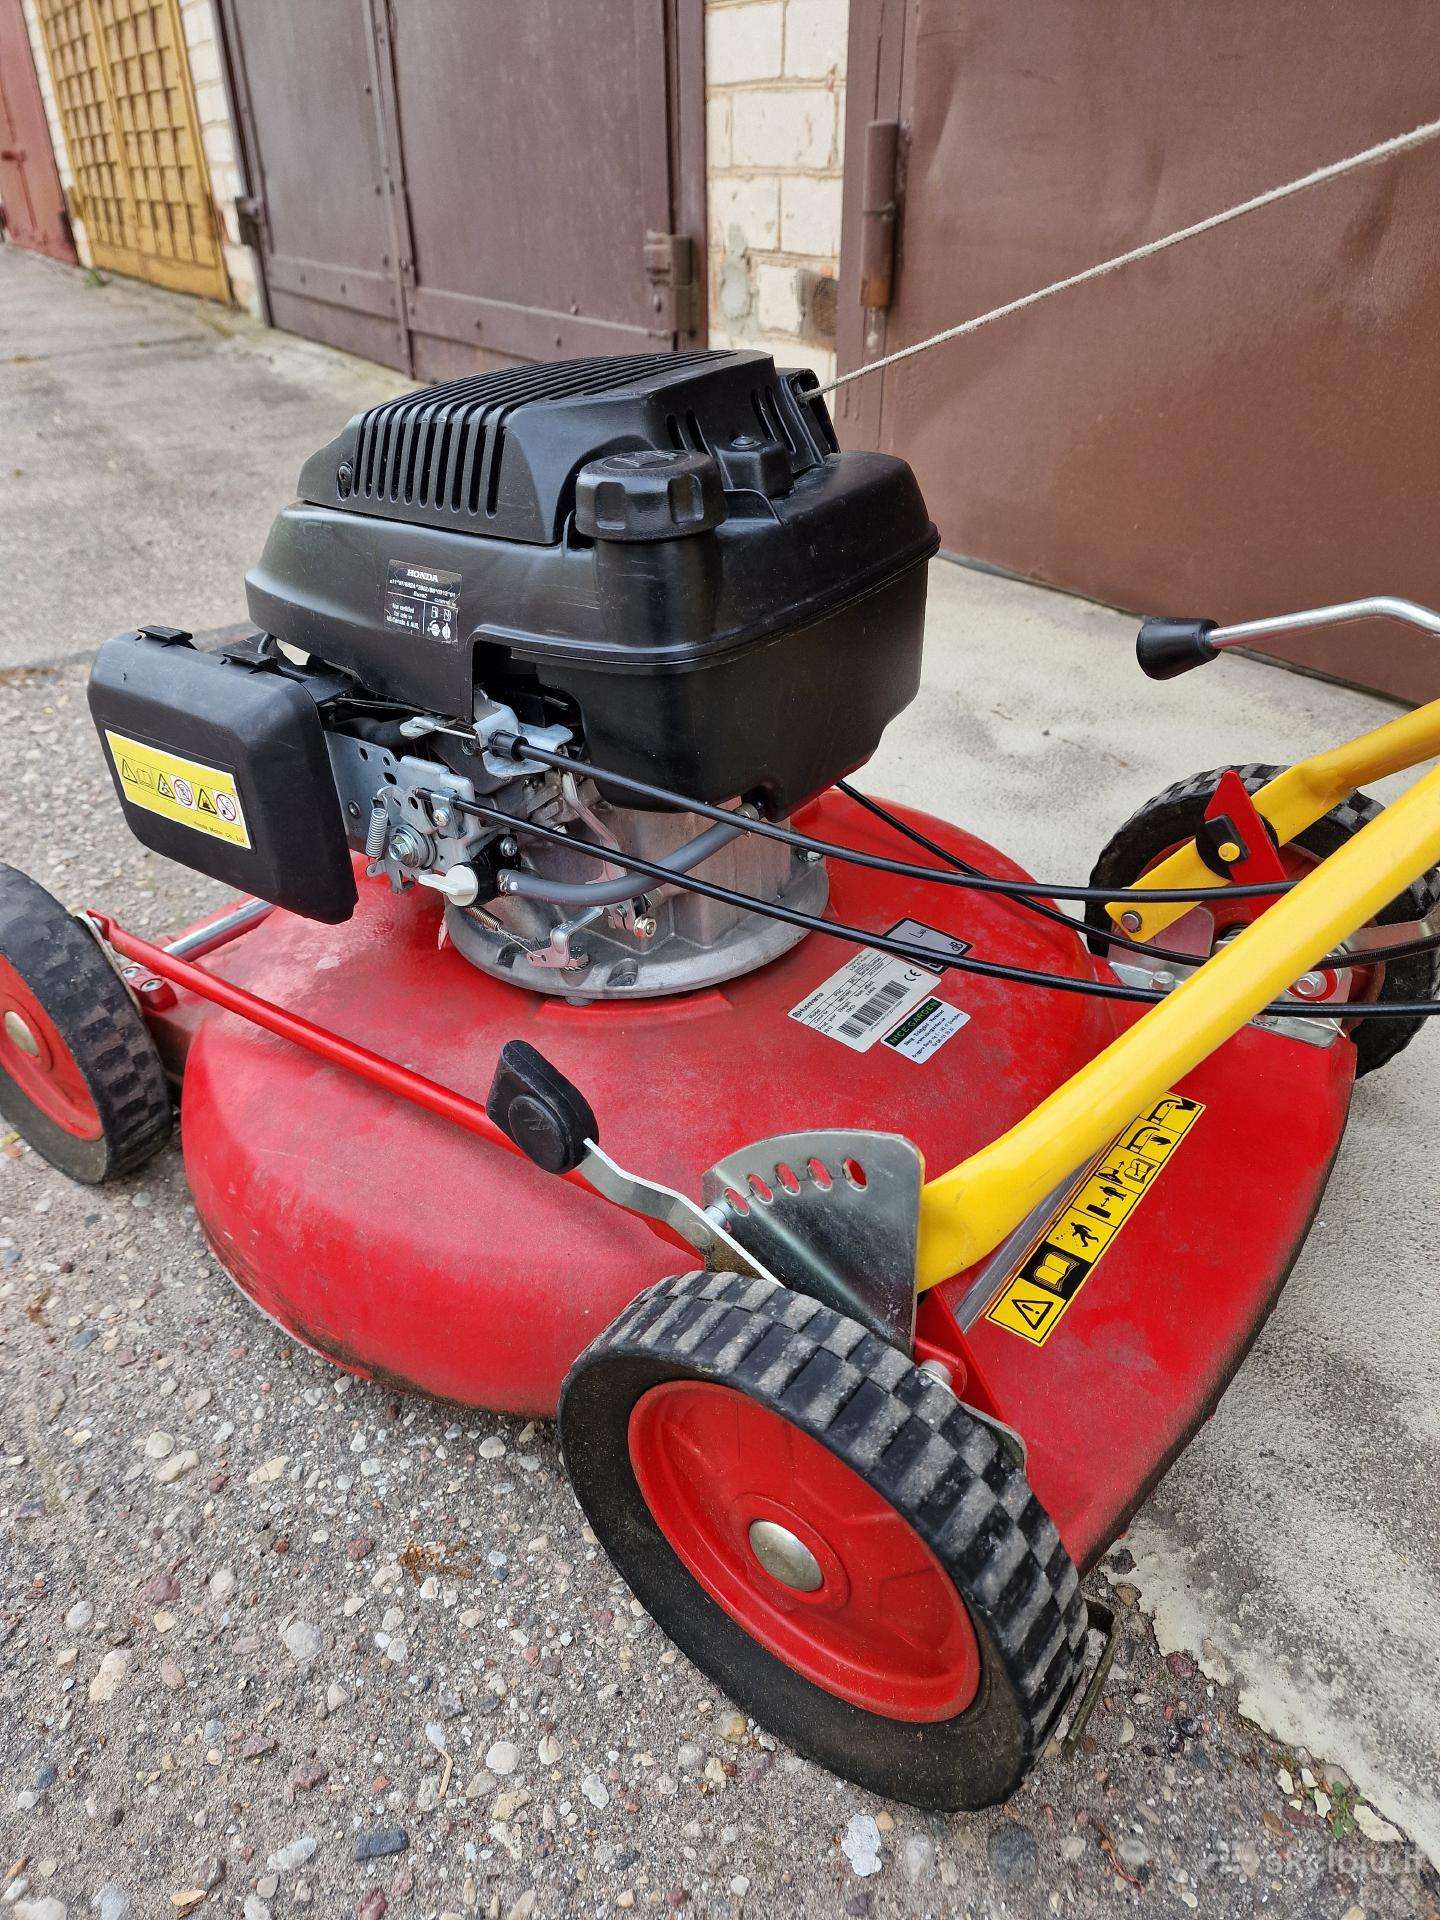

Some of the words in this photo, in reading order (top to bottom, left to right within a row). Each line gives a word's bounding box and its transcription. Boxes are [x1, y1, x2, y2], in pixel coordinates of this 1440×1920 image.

[407, 569, 438, 582] HONDA
[796, 991, 825, 1013] Husqvarna
[888, 1025, 910, 1043] NICE
